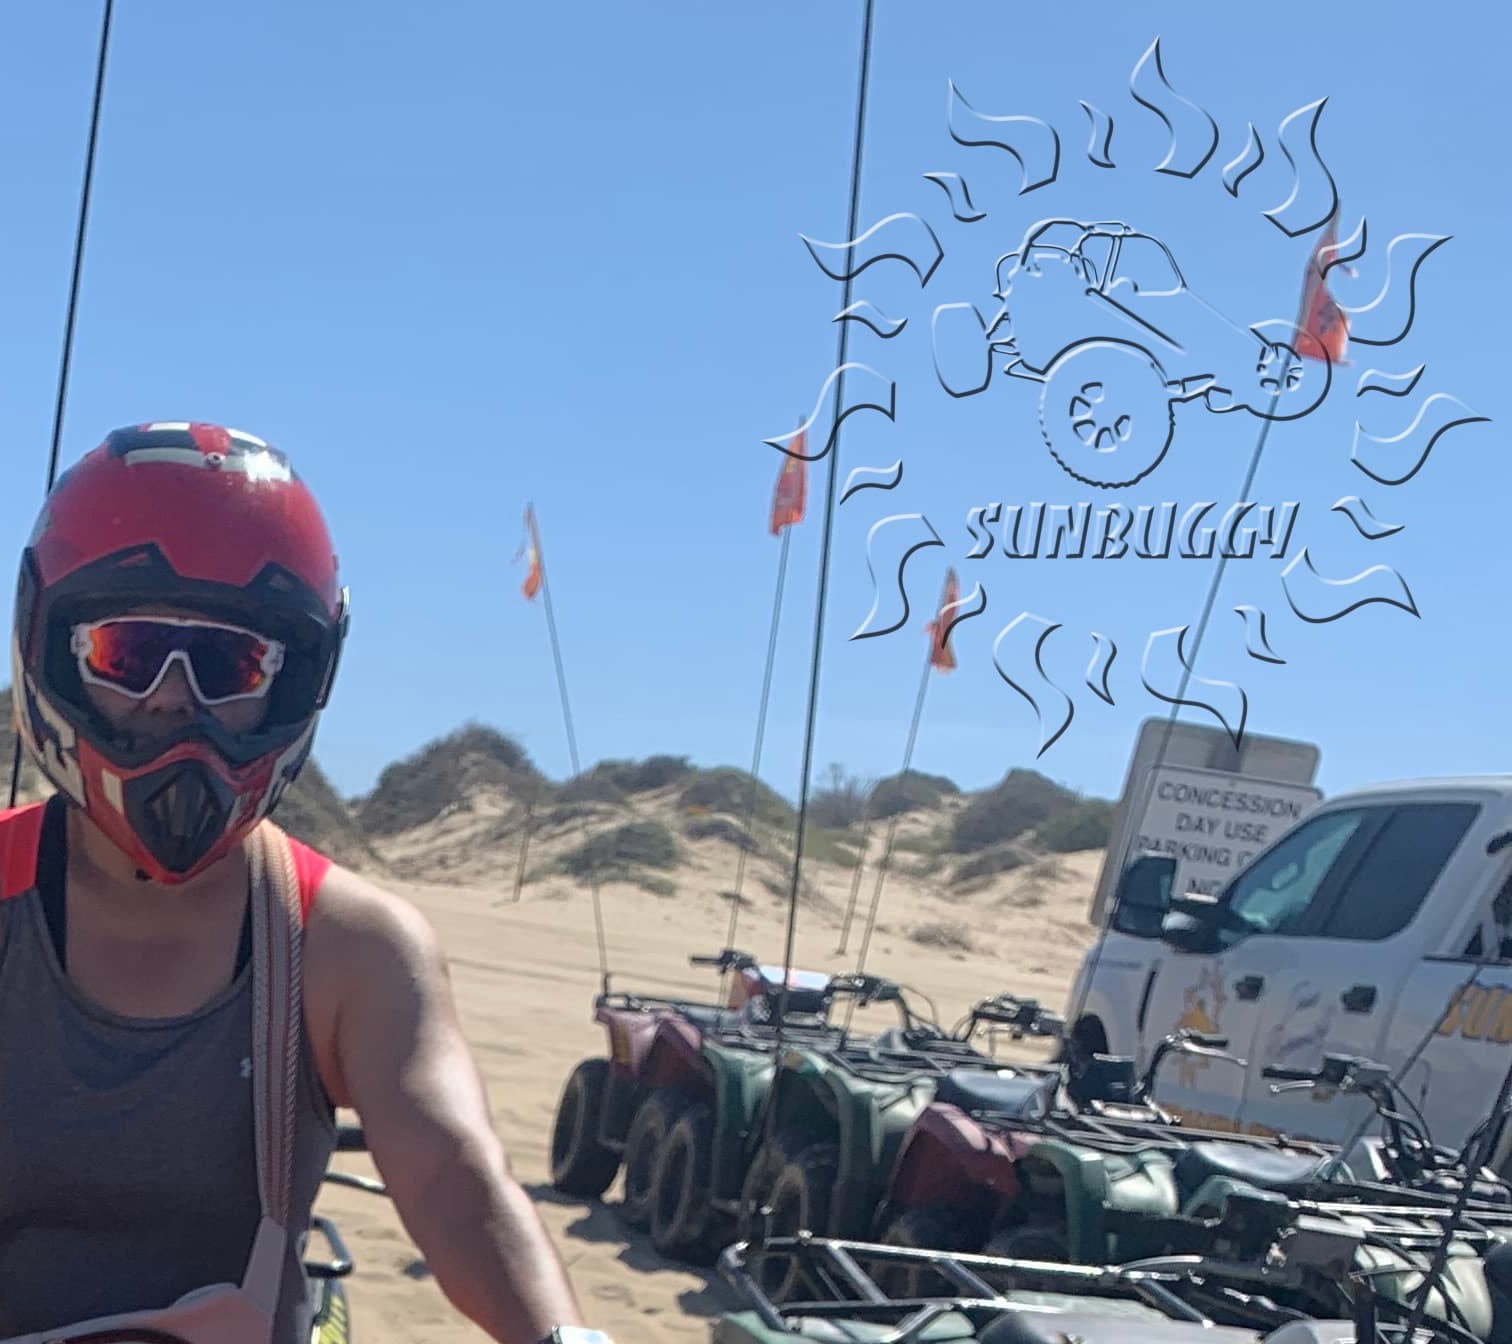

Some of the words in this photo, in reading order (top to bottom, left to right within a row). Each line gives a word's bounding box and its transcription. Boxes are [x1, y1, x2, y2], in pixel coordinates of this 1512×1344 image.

[1157, 781, 1303, 818] CONCESSION
[1175, 812, 1222, 834] DAY
[1223, 820, 1270, 843] USE
[1137, 834, 1233, 868] PARKING
